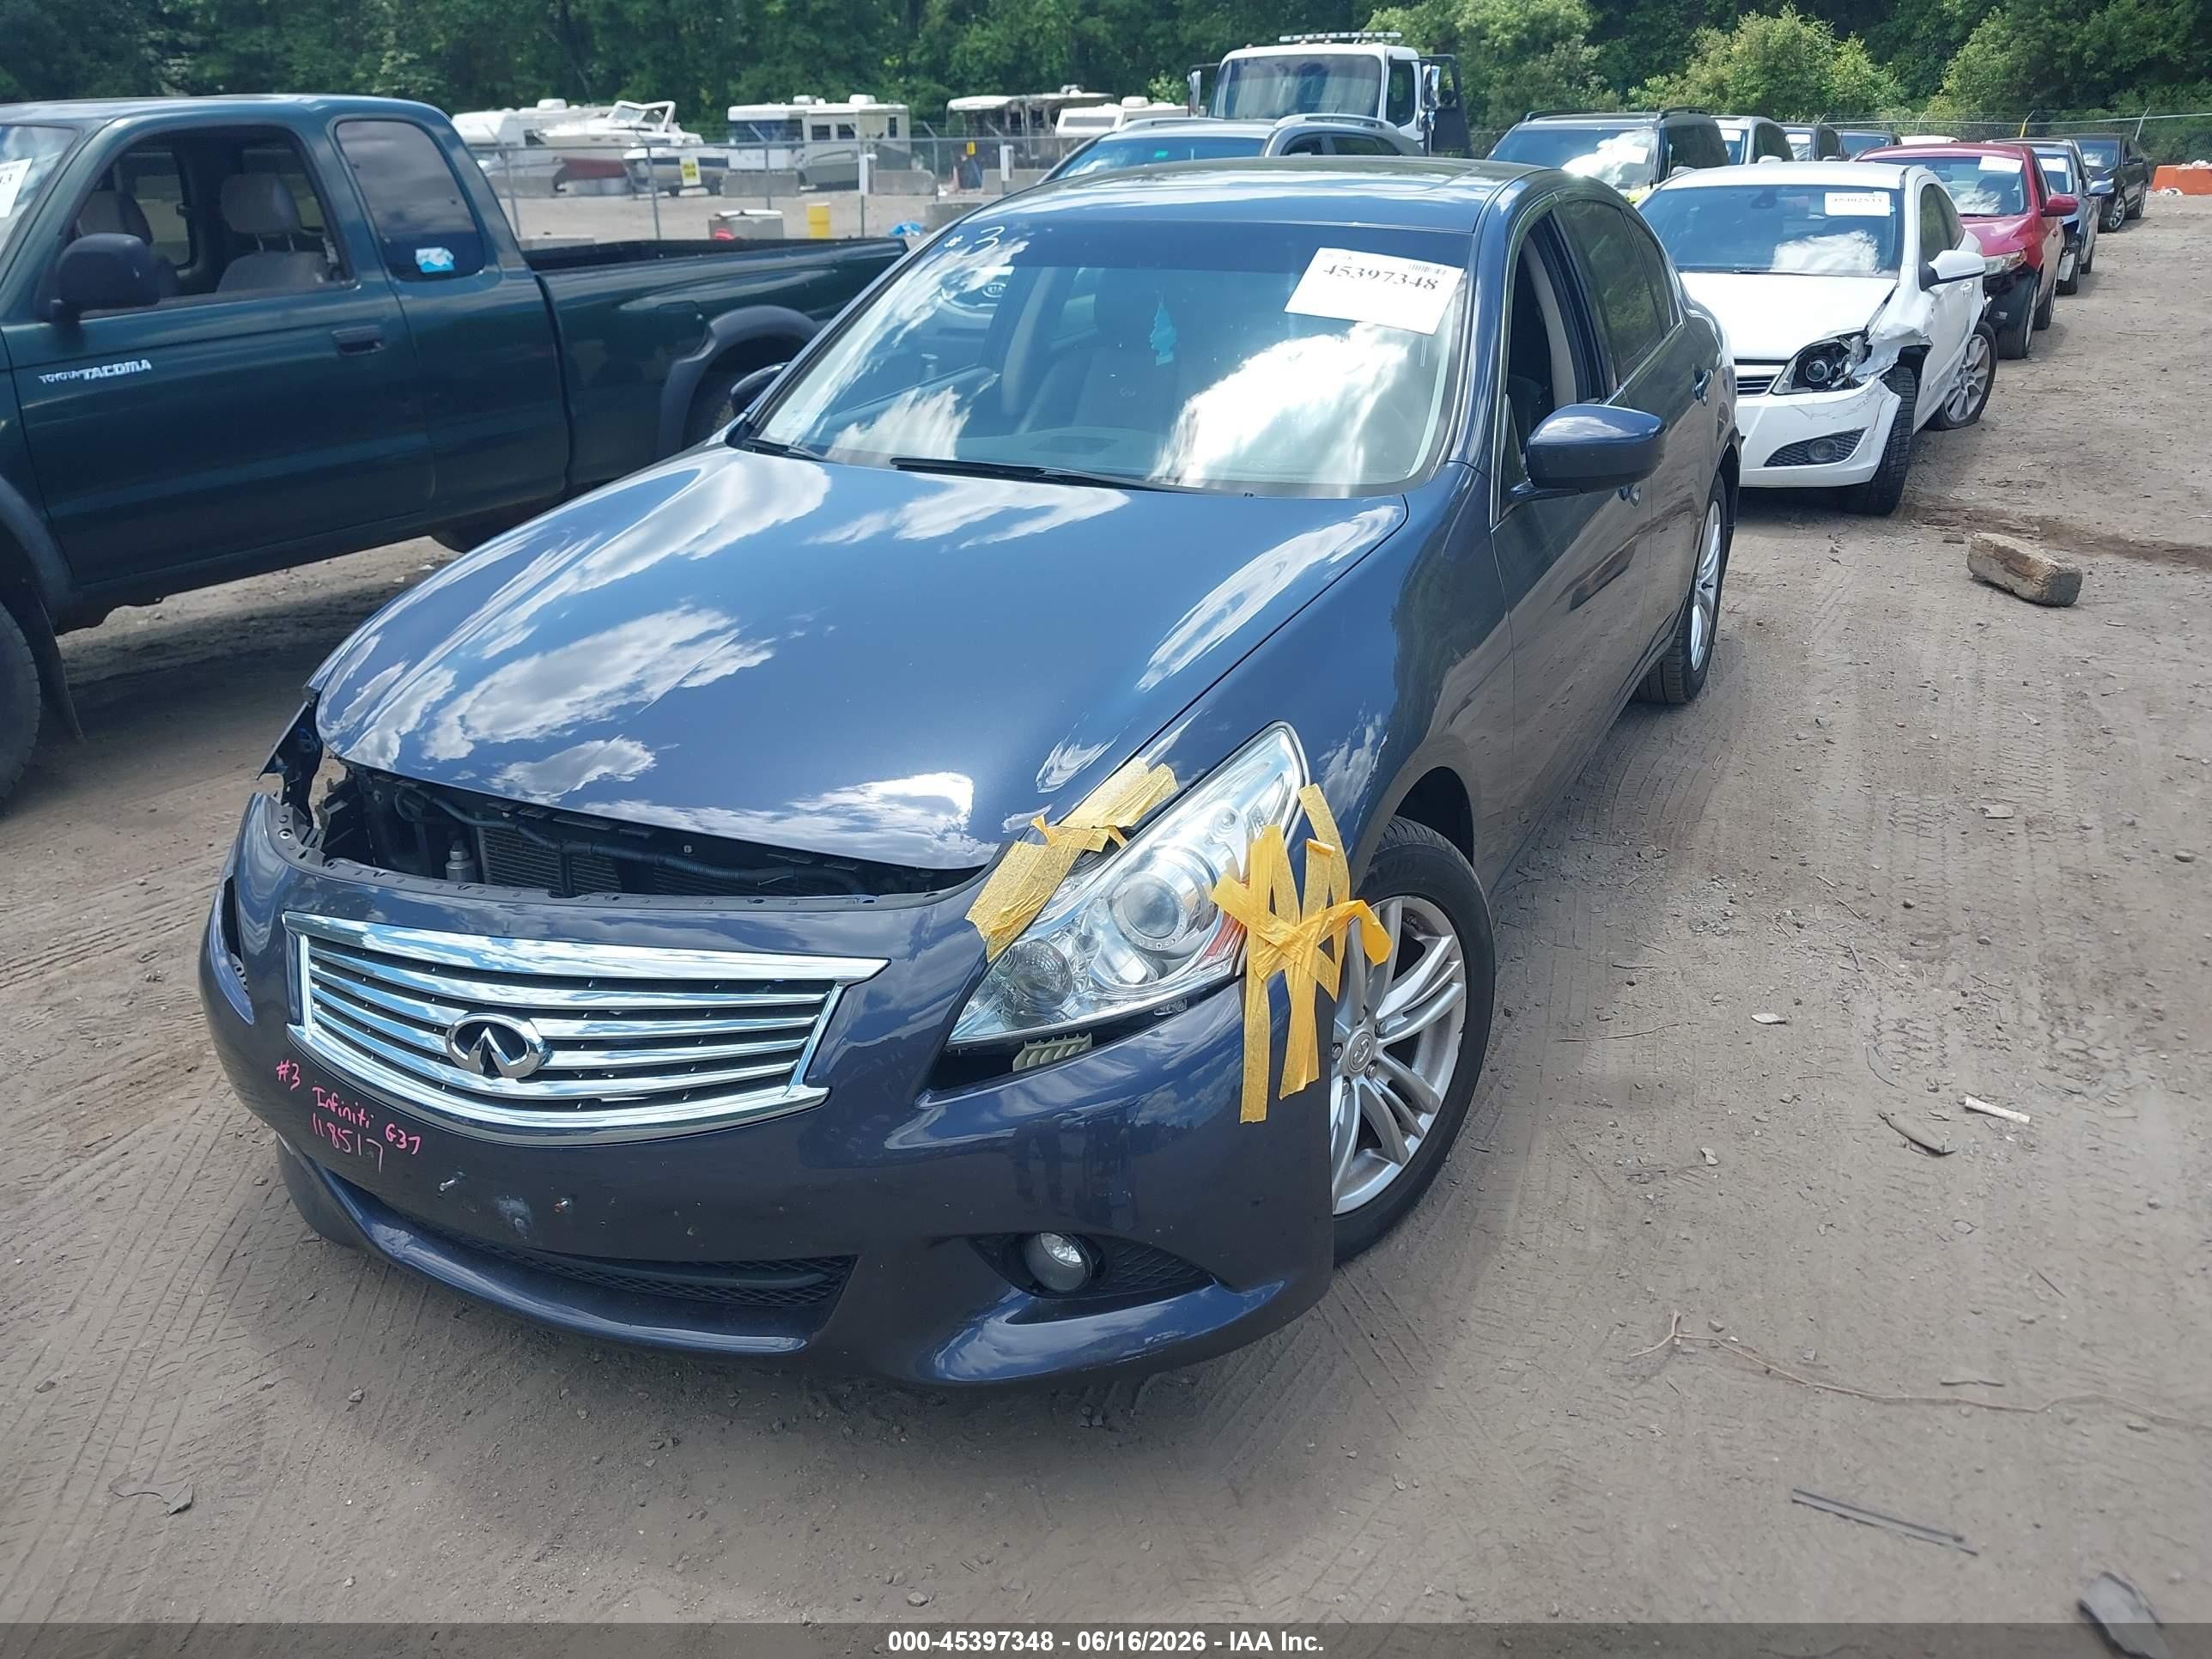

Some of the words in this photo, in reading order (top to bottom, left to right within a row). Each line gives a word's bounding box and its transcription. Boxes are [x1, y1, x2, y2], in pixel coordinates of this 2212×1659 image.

[1322, 264, 1440, 291] 45397348
[81, 359, 152, 380] TACOMA
[276, 1059, 301, 1091] #3
[312, 1086, 374, 1129] Infiniti
[386, 1122, 422, 1155] G37
[312, 1111, 384, 1174] 118517
